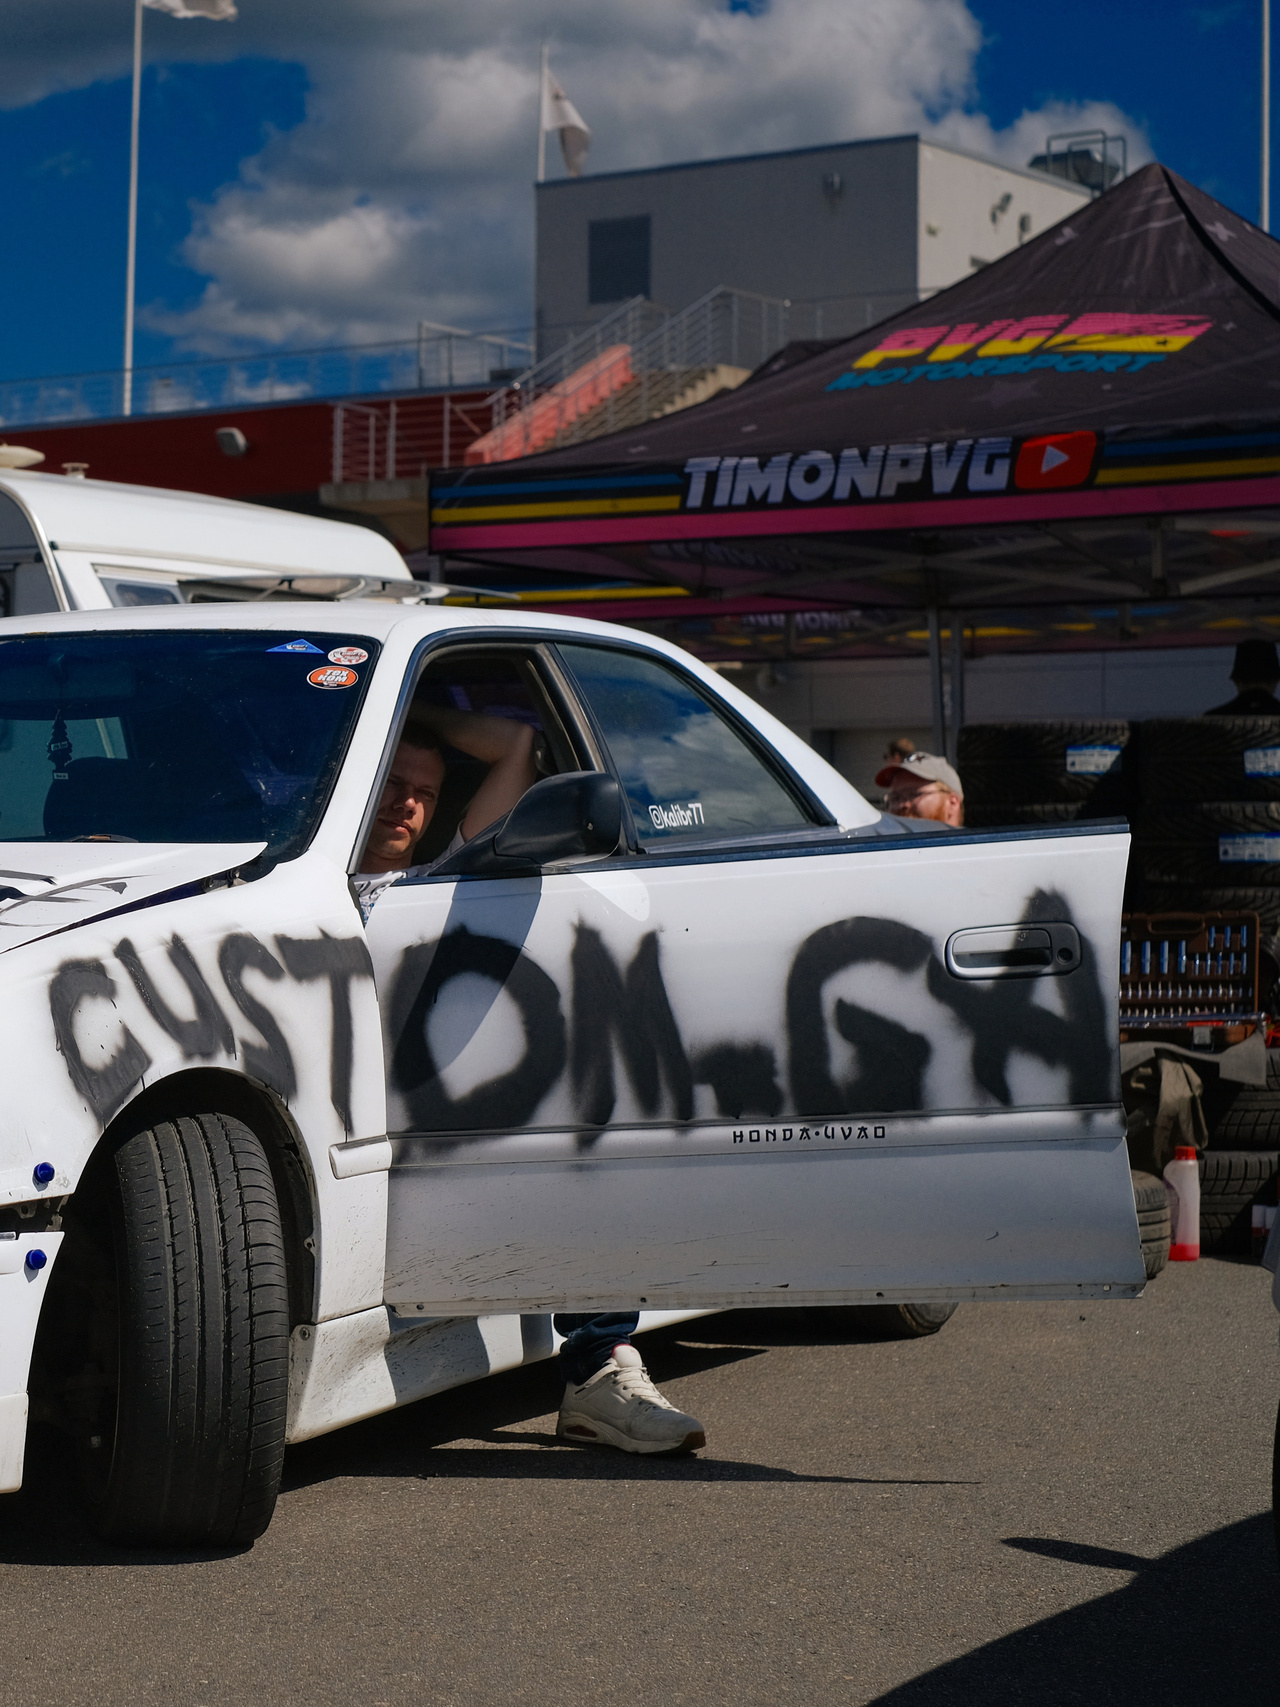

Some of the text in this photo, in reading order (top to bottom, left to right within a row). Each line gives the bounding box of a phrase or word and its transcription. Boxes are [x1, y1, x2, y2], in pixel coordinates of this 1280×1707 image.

[825, 353, 1167, 392] MOTORSPORT
[683, 436, 1013, 509] TIMONPVG
[648, 802, 705, 830] @kalibr77
